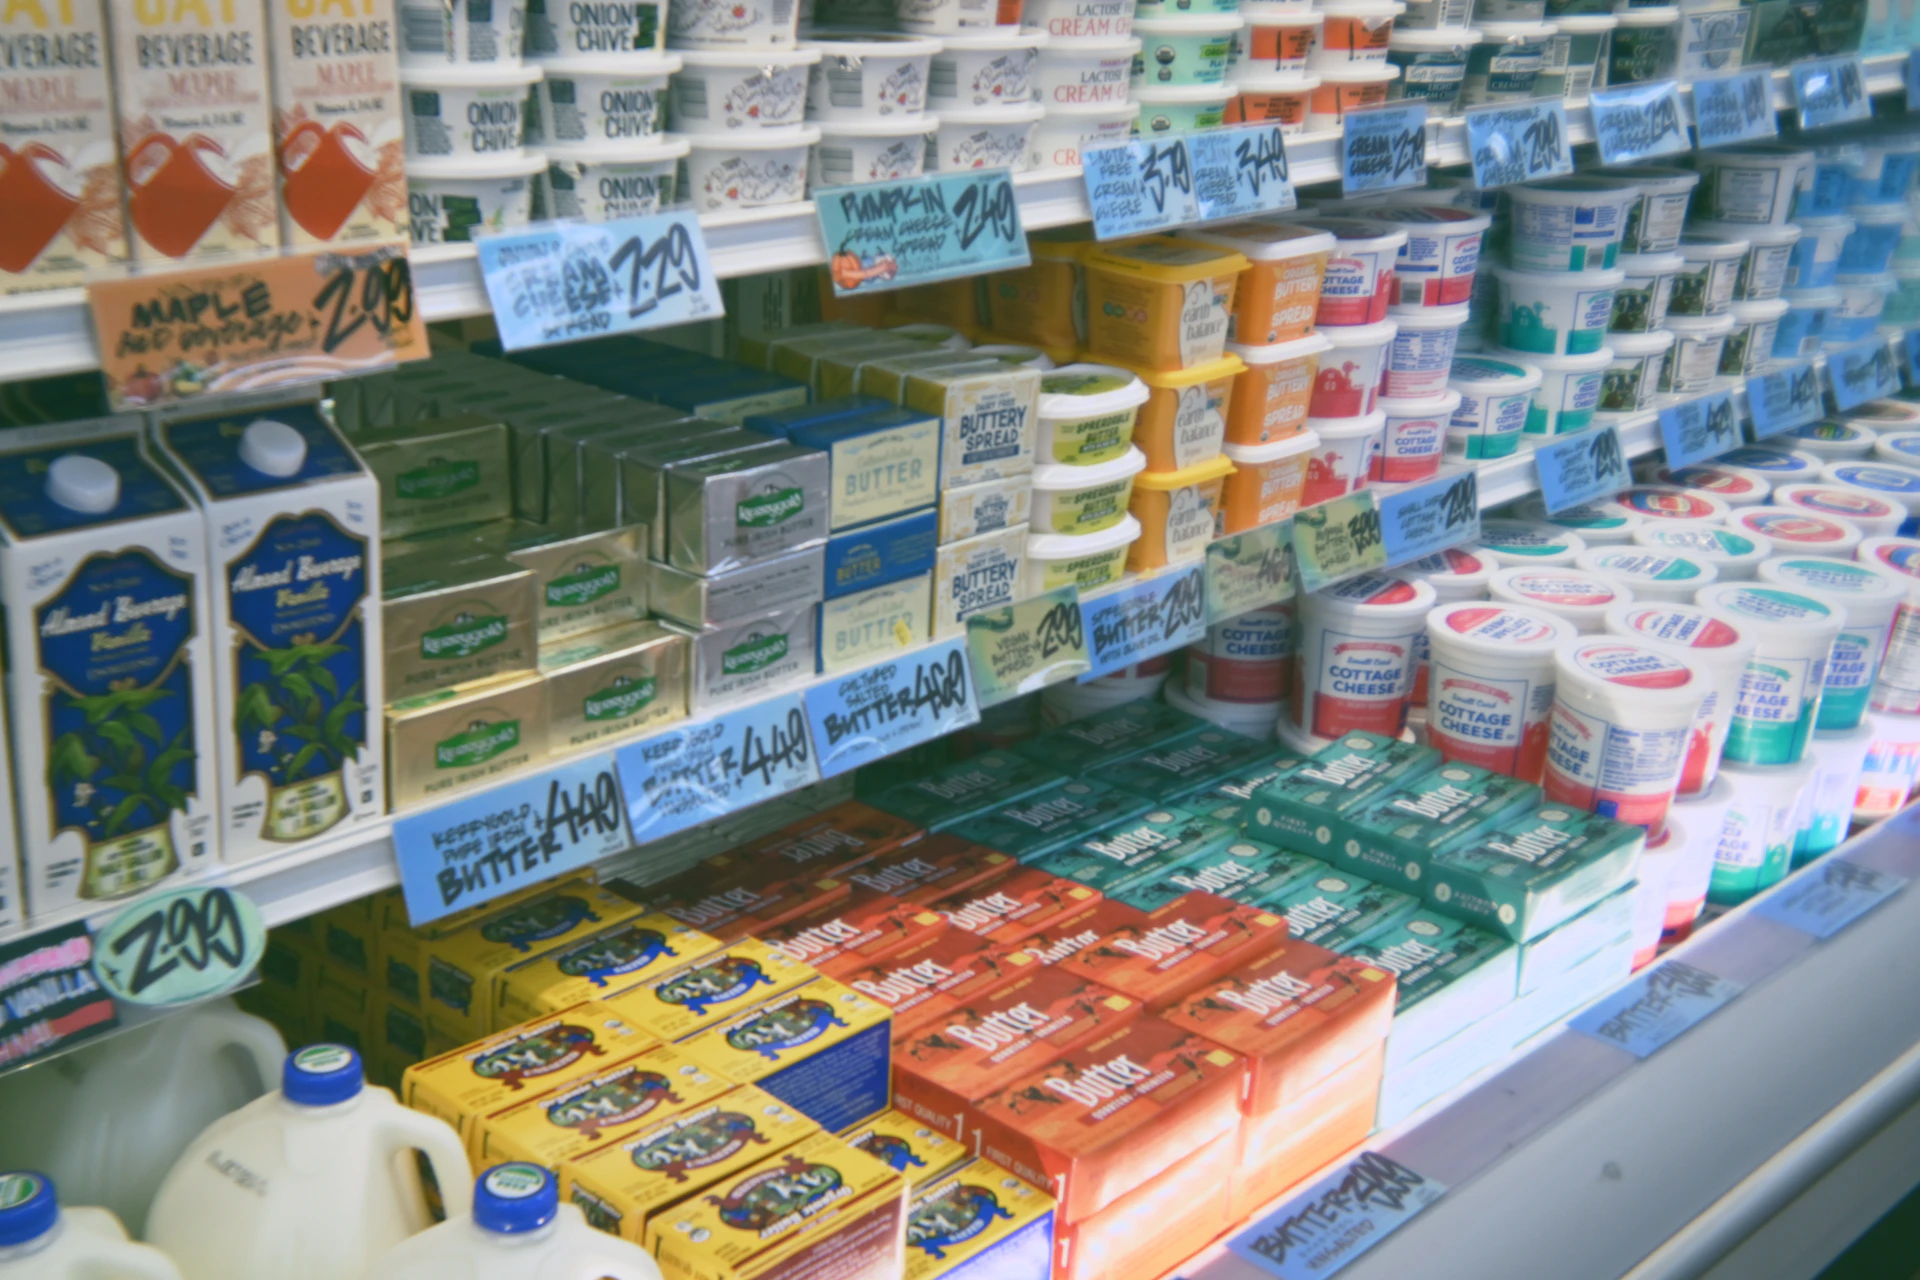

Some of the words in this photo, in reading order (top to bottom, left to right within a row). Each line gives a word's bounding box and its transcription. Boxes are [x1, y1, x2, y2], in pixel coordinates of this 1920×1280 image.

[571, 2, 635, 27] ONION
[1075, 2, 1121, 17] LACTOSE
[291, 21, 391, 58] BEVERAGE
[575, 27, 634, 52] CHIVE
[1048, 17, 1111, 37] CREAM
[137, 31, 254, 69] BEVERAGE
[166, 71, 237, 96] MAPLE
[315, 61, 377, 85] MAPLE
[1081, 69, 1122, 83] LACTOSE
[600, 89, 655, 115] ONION
[1053, 83, 1114, 103] CREAM
[604, 117, 652, 139] CHIVE
[1100, 163, 1133, 179] FREE
[1235, 126, 1289, 198] 3.49
[599, 177, 657, 201] ONION
[1139, 140, 1190, 214] 3.79
[839, 183, 947, 223] PUMPKIN
[1094, 181, 1138, 200] CREAM
[952, 181, 1016, 251] 2.49
[1096, 200, 1143, 220] CHEESE
[844, 222, 896, 245] CREAM
[897, 214, 956, 236] CHEESE
[891, 232, 946, 256] SPREAD
[1274, 276, 1321, 300] BUTTERY
[131, 281, 272, 329] MAPLE
[313, 256, 413, 354] 2.99
[1182, 303, 1212, 323] earth
[1270, 305, 1314, 327] SPREAD
[1187, 318, 1223, 342] balance
[1267, 375, 1312, 401] BUTTERY
[959, 405, 1028, 438] BUTTERY
[1176, 407, 1206, 428] earth
[1263, 404, 1306, 427] SPREAD
[965, 429, 1019, 451] SPREAD
[1181, 420, 1218, 444] balance
[1394, 435, 1437, 447] COTTAGE
[1397, 444, 1434, 455] CHEESE
[844, 457, 924, 497] BUTTER
[1261, 471, 1304, 499] BUTTERY
[1167, 507, 1198, 527] earth
[1171, 519, 1211, 544] balance
[231, 559, 294, 593] Almond
[296, 554, 362, 582] Beverage
[951, 559, 1018, 599] BUTTERY
[275, 580, 330, 608] Vanilla
[958, 582, 1012, 608] SPREAD
[41, 600, 111, 638] Almond
[113, 594, 188, 623] Beverage
[91, 621, 152, 651] Vanilla
[1093, 605, 1162, 656] BUTTER
[1221, 627, 1291, 641] COTTAGE
[1226, 642, 1288, 656] CHEESE
[1347, 656, 1375, 666] Small
[1375, 657, 1393, 666] Curd
[1329, 664, 1403, 682] COTTAGE
[1589, 655, 1662, 670] COTTAGE
[1605, 662, 1664, 676] CHEESE
[844, 684, 890, 709] SALTED
[1332, 680, 1396, 696] CHEESE
[1452, 693, 1478, 705] Small
[1478, 697, 1497, 709] Curd
[823, 686, 912, 746] BUTTER
[1438, 700, 1512, 726] COTTAGE
[1441, 716, 1504, 740] CHEESE
[741, 708, 808, 786] 4.49
[1301, 753, 1378, 785] Butter
[546, 771, 620, 844] 4.49
[1003, 795, 1084, 828] Butter
[1394, 783, 1475, 820] Butter
[1273, 820, 1315, 838] QUALITY
[1084, 825, 1168, 861] Butter
[1486, 824, 1572, 863] Butter
[435, 829, 563, 907] BUTTER
[1361, 851, 1404, 874] QUALITY
[848, 857, 938, 895] Butter
[1171, 858, 1257, 896] Butter
[942, 890, 1024, 934] Butter
[110, 887, 246, 997] 2.99
[764, 917, 862, 961] Butter
[1112, 917, 1209, 962] Butter
[691, 953, 729, 971] Butter
[851, 958, 954, 1004] Butter
[1216, 969, 1314, 1017] Butter
[716, 1010, 764, 1035] Organic
[763, 994, 801, 1015] Butter
[944, 1001, 1052, 1053] Butter
[592, 1065, 637, 1088] Butter
[1042, 1052, 1153, 1108] Butter
[622, 1124, 677, 1152] Organic
[675, 1105, 719, 1129] Butter
[913, 1102, 952, 1130] QUALITY
[953, 1113, 965, 1143] 1
[971, 1128, 983, 1159] 1
[985, 1144, 1013, 1168] FIRST
[1012, 1157, 1054, 1188] QUALITY
[1247, 1172, 1354, 1265] BUTTER
